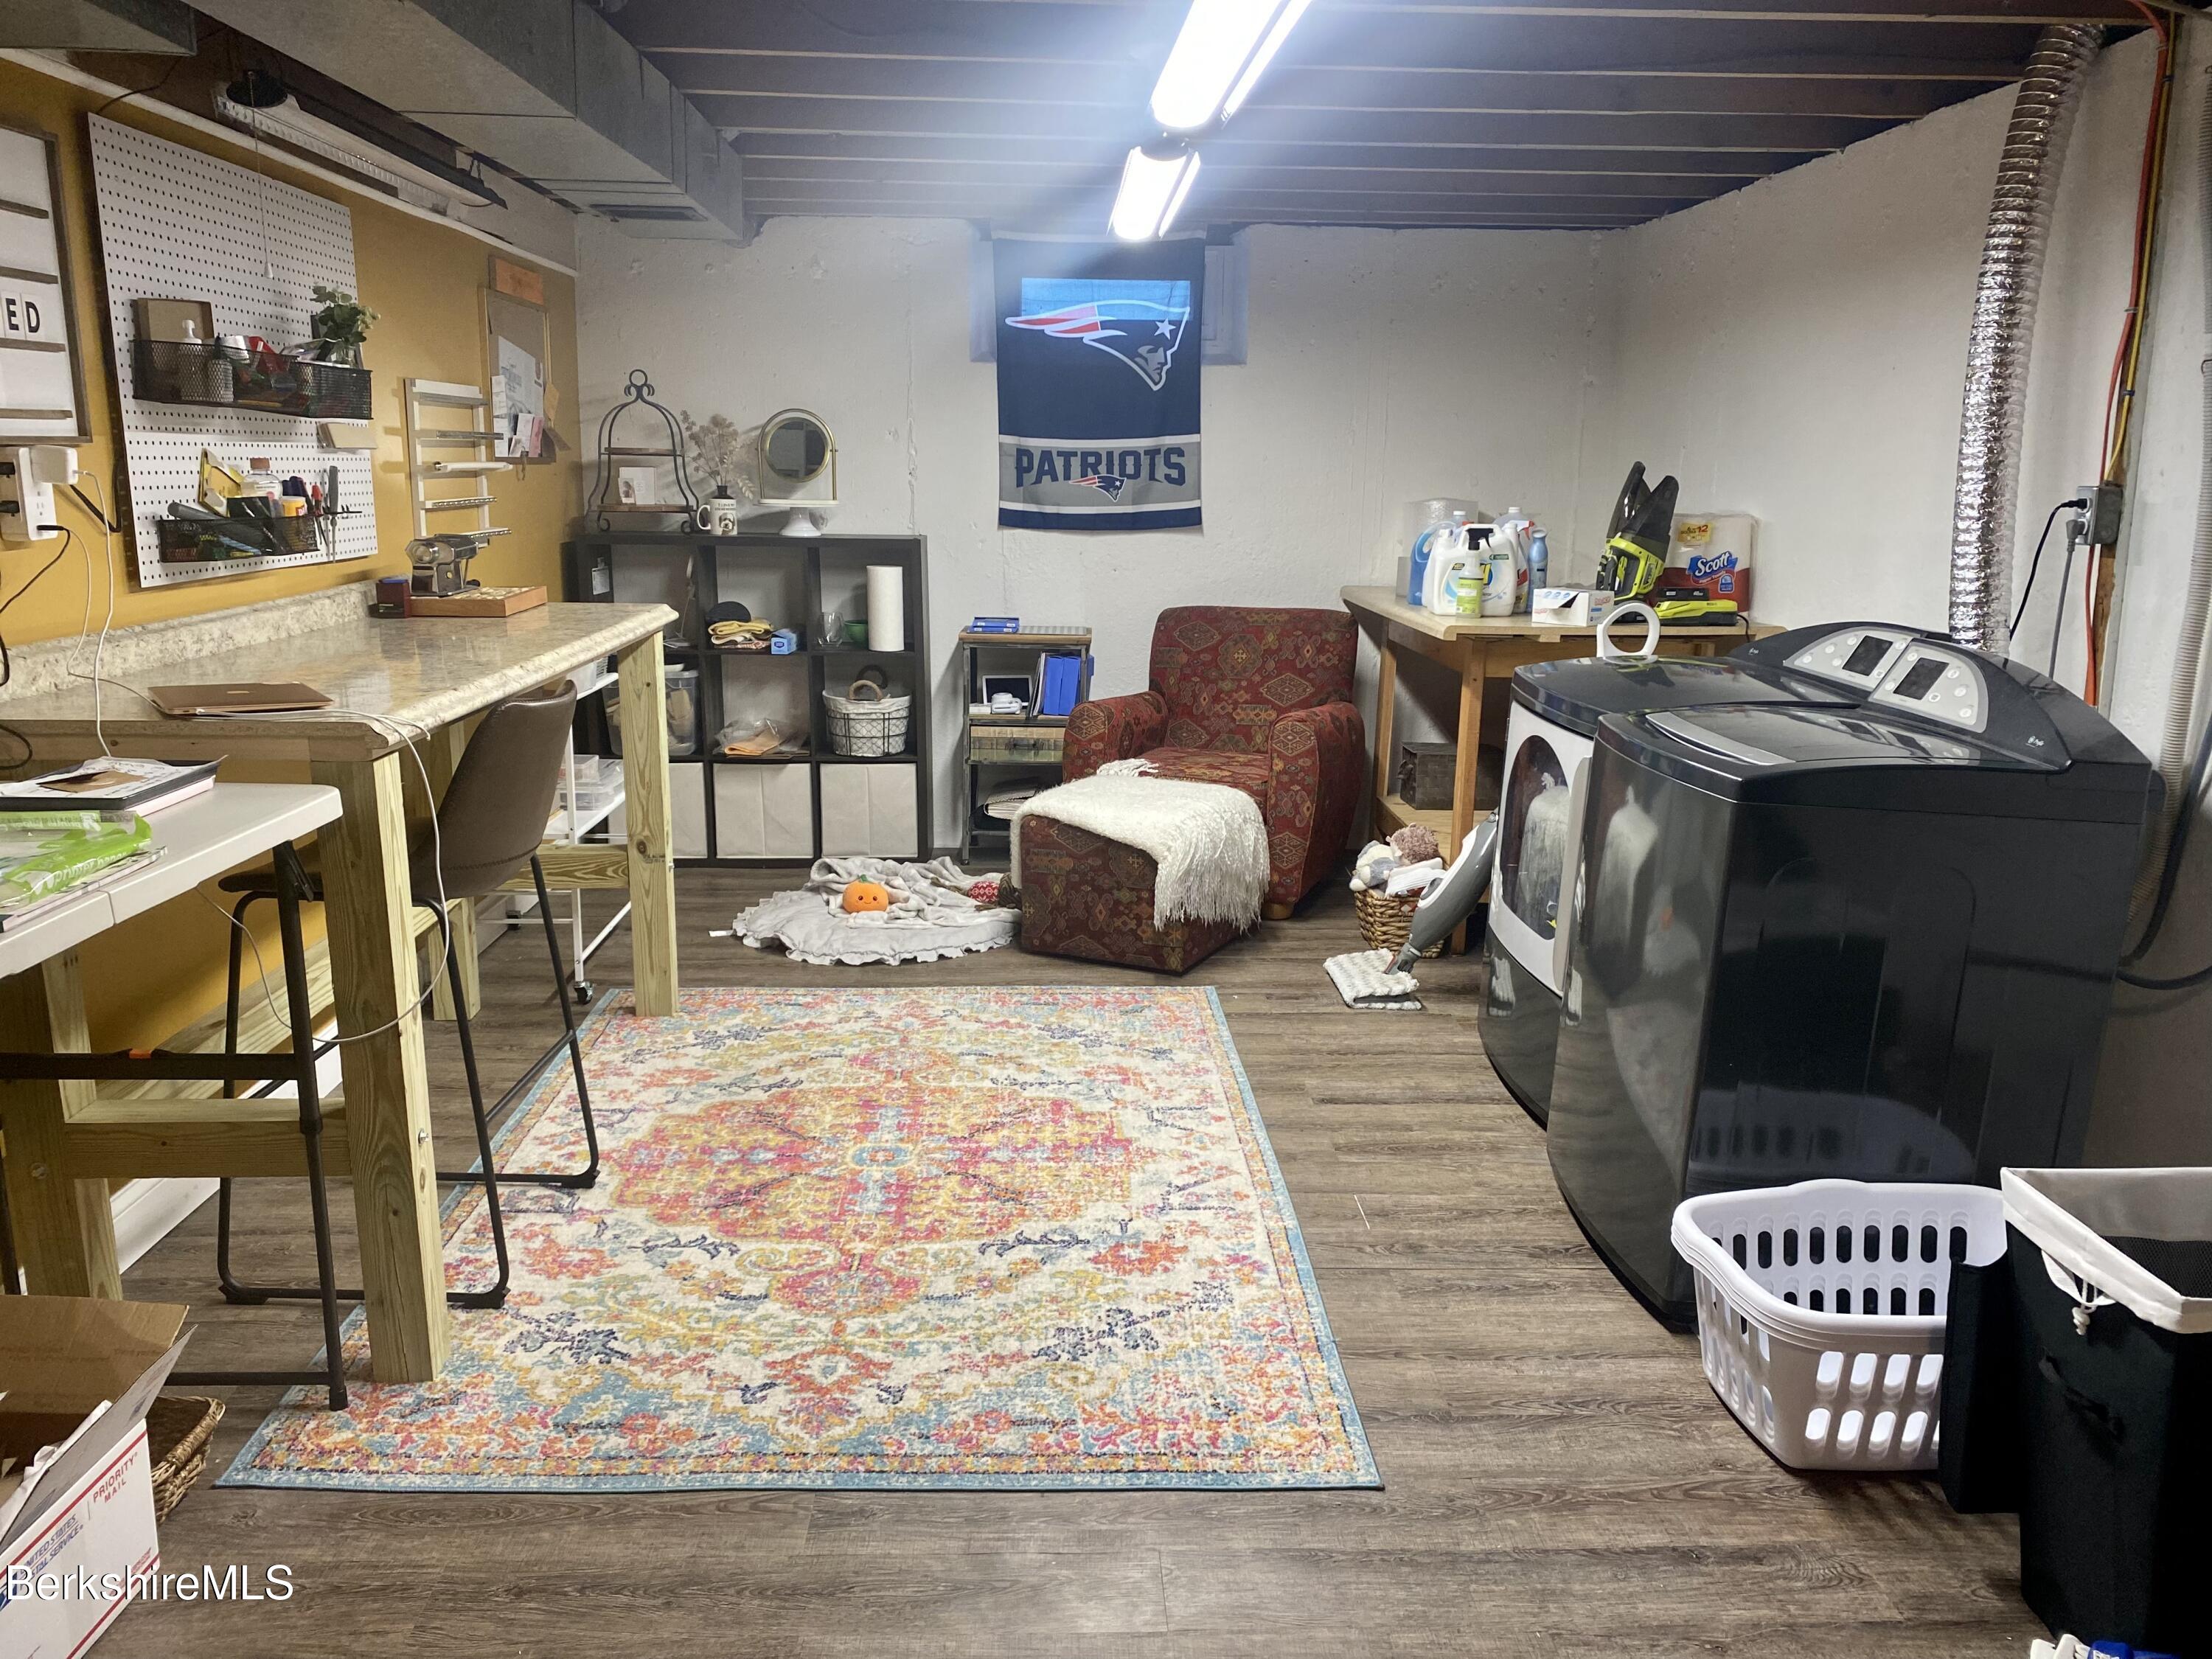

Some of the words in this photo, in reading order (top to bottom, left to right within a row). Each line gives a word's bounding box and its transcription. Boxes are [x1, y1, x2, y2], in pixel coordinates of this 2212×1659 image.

[1015, 447, 1186, 488] PATRIOTS
[1695, 552, 1730, 577] Scott
[105, 1478, 126, 1503] MAIL
[50, 1514, 76, 1545] STATES
